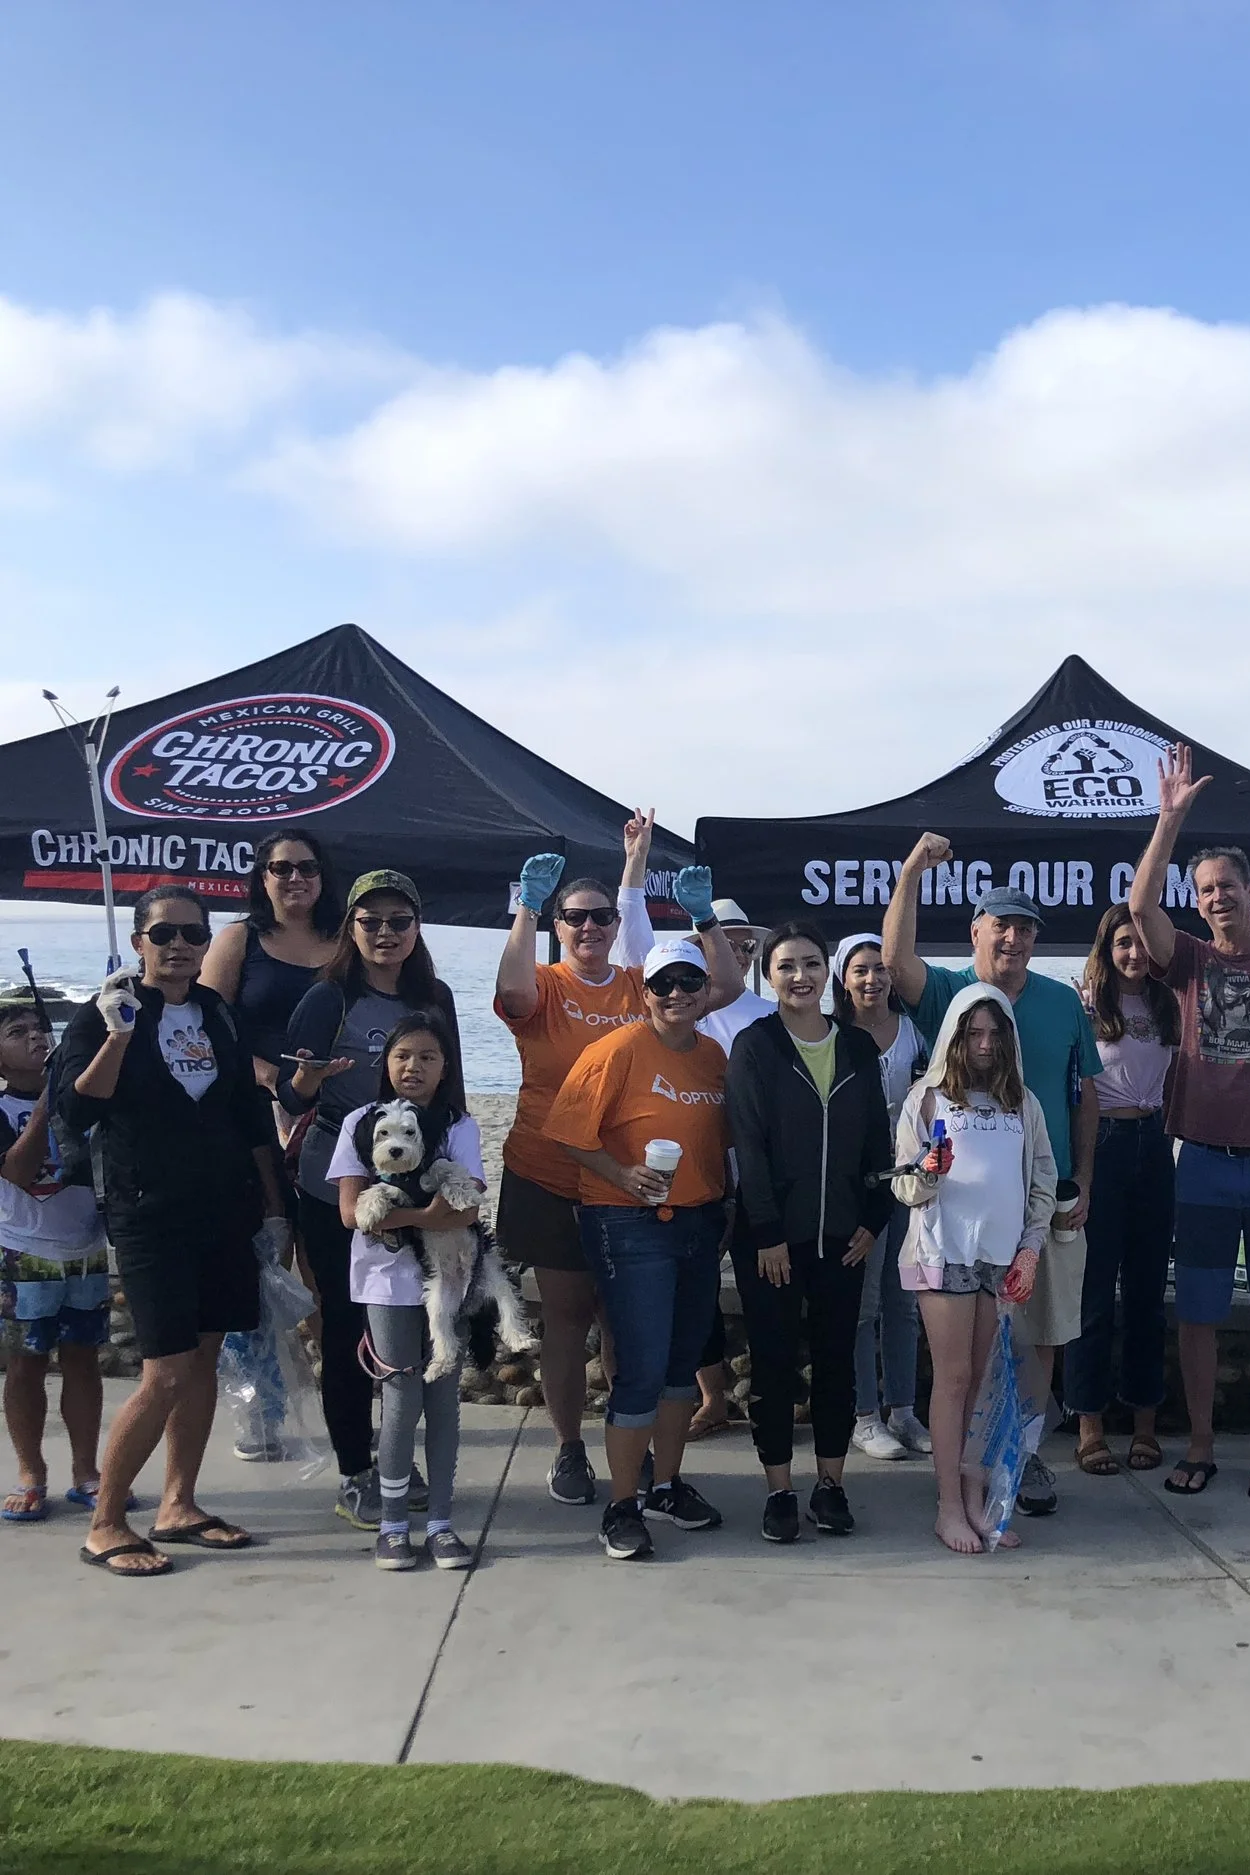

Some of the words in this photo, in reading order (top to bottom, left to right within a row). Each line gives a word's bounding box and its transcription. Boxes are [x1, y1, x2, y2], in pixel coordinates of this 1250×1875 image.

[198, 705, 310, 728] MEXICAN
[316, 709, 363, 735] GRILL
[152, 731, 373, 768] CHRONIC
[990, 724, 1059, 766] PROTECTING
[1062, 719, 1091, 731] OUR
[164, 759, 328, 793] TACOS
[1043, 775, 1142, 800] ECO
[144, 797, 207, 815] SINCE
[217, 803, 290, 816] 2002
[1003, 804, 1058, 818] SERVING
[1097, 806, 1161, 819] COMMUN
[1045, 799, 1145, 808] WARRIOR
[31, 829, 187, 870] CHRONIC
[190, 837, 256, 874] TAC
[1008, 861, 1095, 906] OUR
[586, 1013, 646, 1027] OPTUM
[1209, 1036, 1225, 1046] BOB
